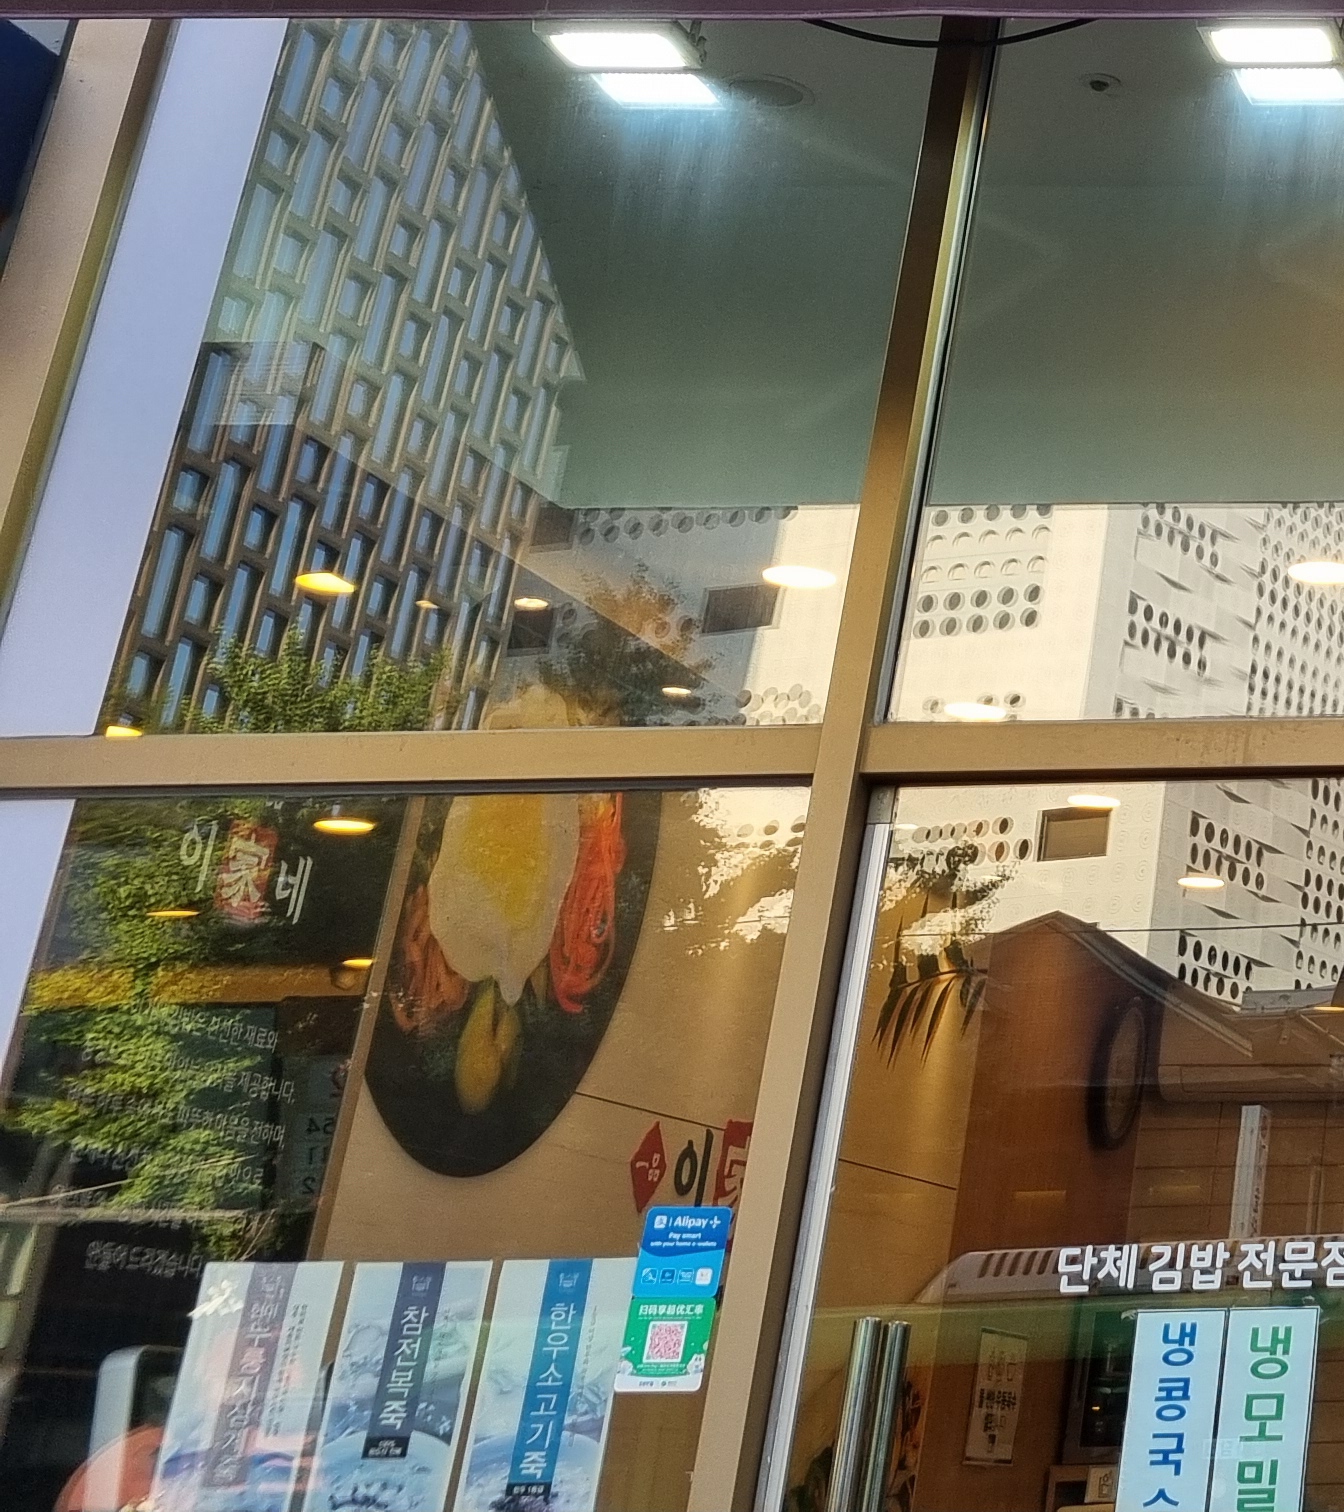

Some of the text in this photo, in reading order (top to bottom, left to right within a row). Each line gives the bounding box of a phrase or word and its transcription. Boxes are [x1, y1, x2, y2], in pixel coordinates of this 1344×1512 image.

[1057, 1243, 1139, 1294] 단체
[1148, 1241, 1231, 1292] 김밥
[379, 1306, 430, 1430] 참전복죽
[519, 1302, 577, 1479] 한우소고기죽
[1236, 1325, 1293, 1511] 냉모밀
